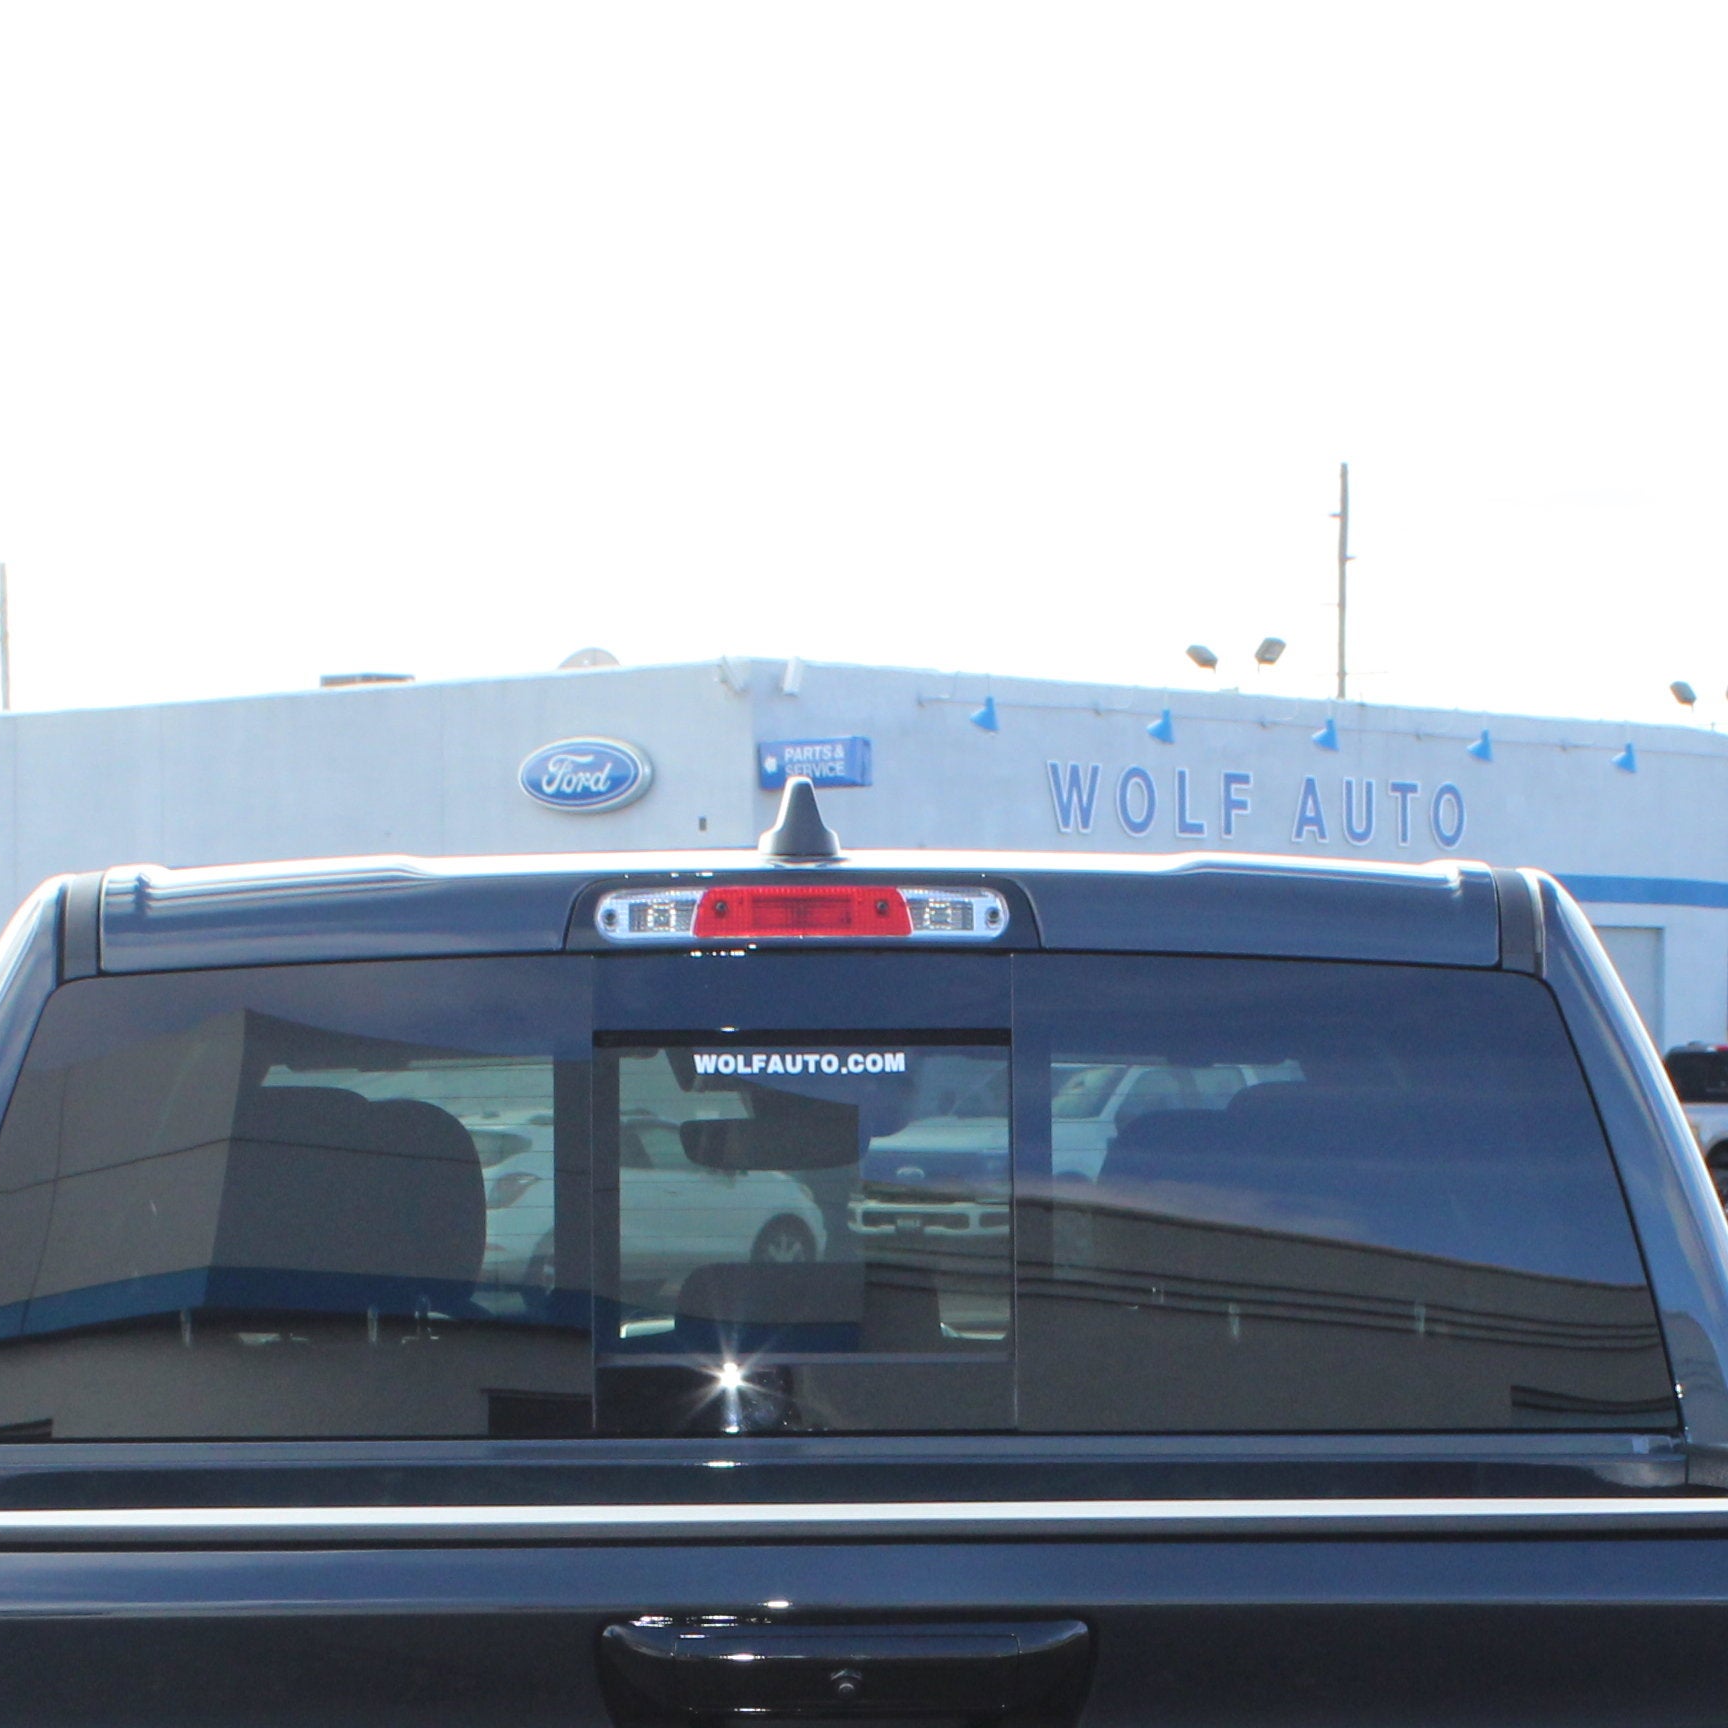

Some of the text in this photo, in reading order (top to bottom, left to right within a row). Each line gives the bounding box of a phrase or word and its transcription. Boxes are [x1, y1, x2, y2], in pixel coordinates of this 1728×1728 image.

[784, 745, 832, 762] PARTS
[541, 754, 613, 794] Ford
[785, 761, 846, 778] SERVICE
[1047, 761, 1466, 849] WOLF AUTO
[693, 1053, 906, 1075] WOLFAUTO.COM
